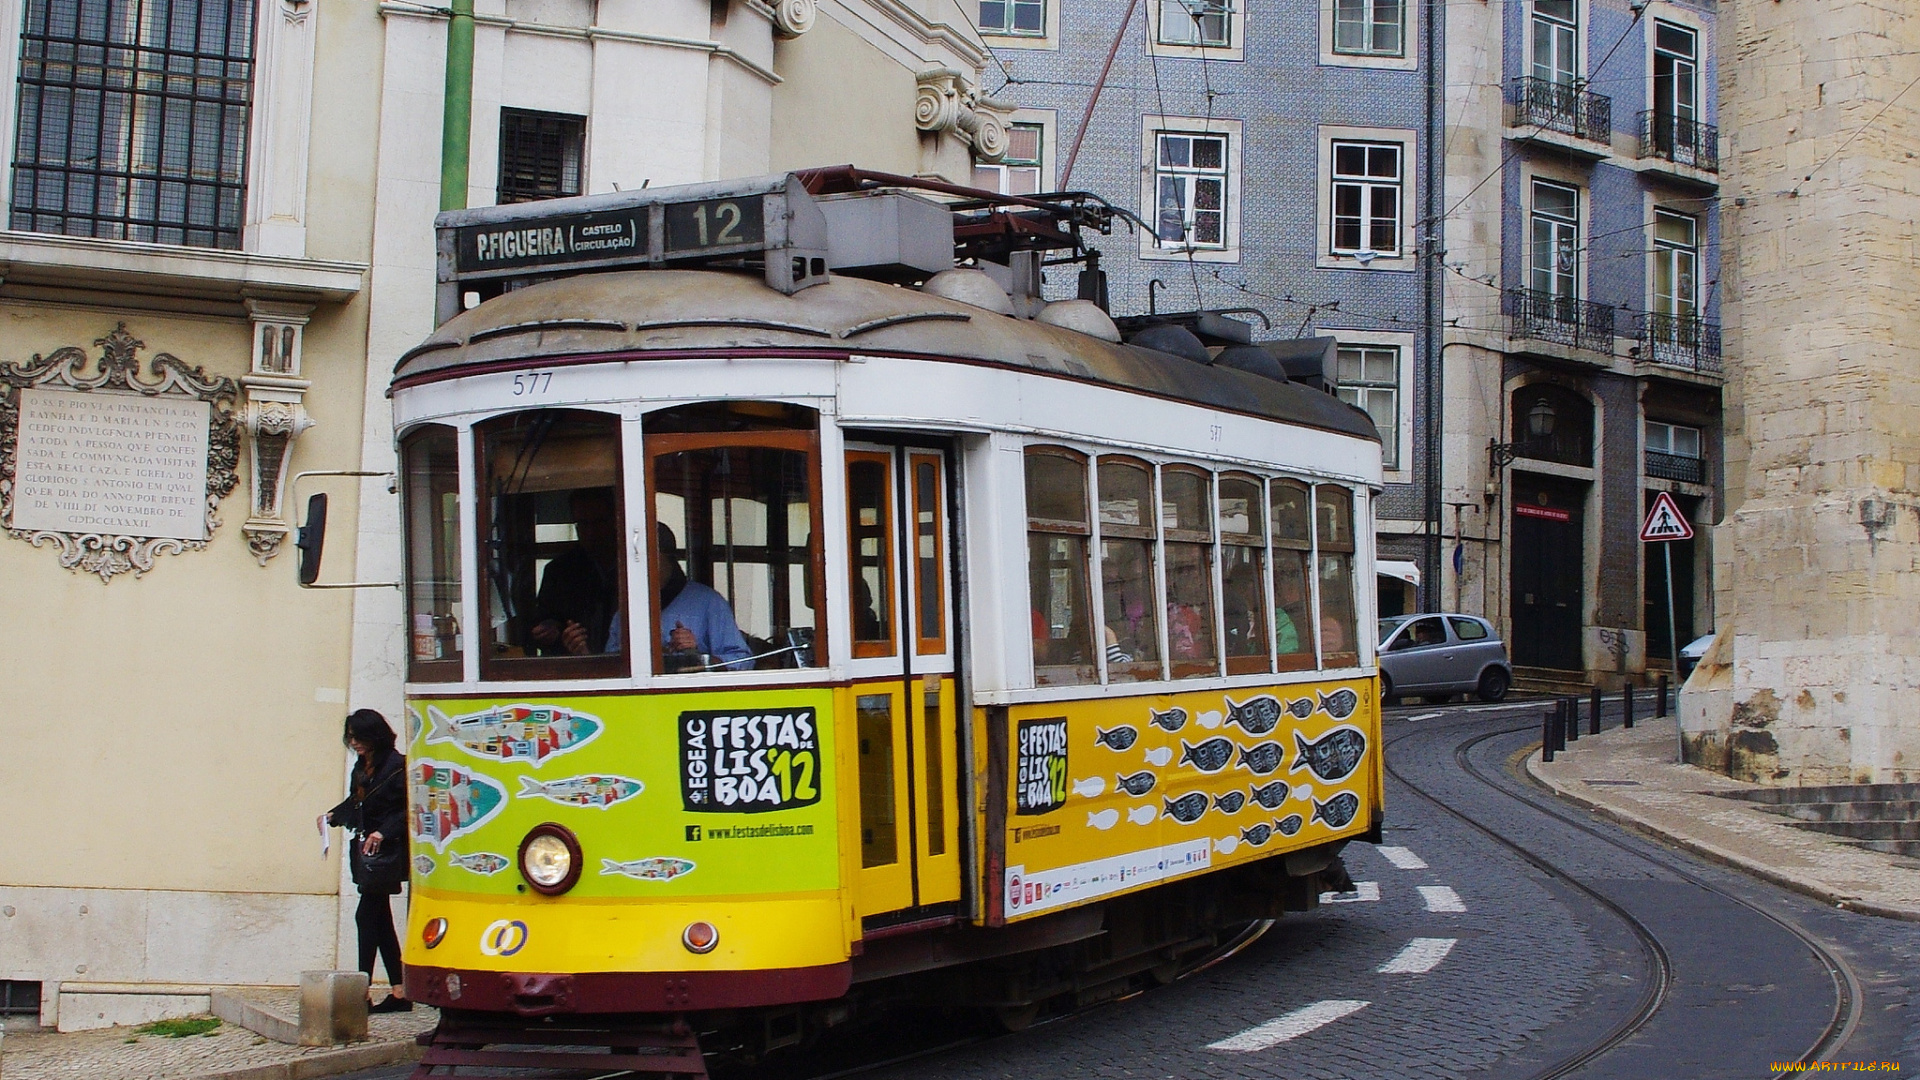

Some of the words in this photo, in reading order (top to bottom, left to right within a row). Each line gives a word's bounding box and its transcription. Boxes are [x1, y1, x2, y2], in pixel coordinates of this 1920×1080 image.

[582, 224, 622, 236] CASTELO
[693, 203, 743, 245] 12
[477, 227, 565, 261] P.FIGUEIRA
[575, 237, 631, 251] CIRCULAÇÃO
[513, 373, 553, 396] 577
[70, 401, 87, 409] PIO
[118, 404, 177, 416] INSTANCIA
[104, 415, 139, 426] MARIA
[1210, 425, 1222, 442] 577
[40, 437, 68, 446] TODA
[86, 441, 123, 450] PESSOA
[128, 443, 150, 452] QVE
[156, 446, 197, 455] CONFES
[27, 449, 54, 458] SADA
[61, 451, 68, 459] E
[156, 458, 198, 468] VISITAR
[27, 462, 52, 471] ESTA
[58, 464, 85, 473] REAL
[125, 468, 131, 476] E
[25, 474, 78, 485] GLORIOSO
[94, 480, 144, 489] ANTONIO
[148, 482, 162, 490] EM
[59, 489, 77, 498] DIA
[83, 491, 98, 499] DO
[162, 496, 196, 506] BREVE
[35, 501, 49, 509] DE
[105, 505, 164, 516] NOVEMBRO
[712, 713, 813, 749] FESTAS
[1029, 722, 1067, 755] FESTAS
[687, 719, 708, 789] EGEAC
[800, 741, 814, 749] DE
[714, 749, 769, 782] LIS
[1029, 756, 1050, 786] LIS
[715, 776, 781, 806] BOA
[1028, 781, 1052, 809] BOA
